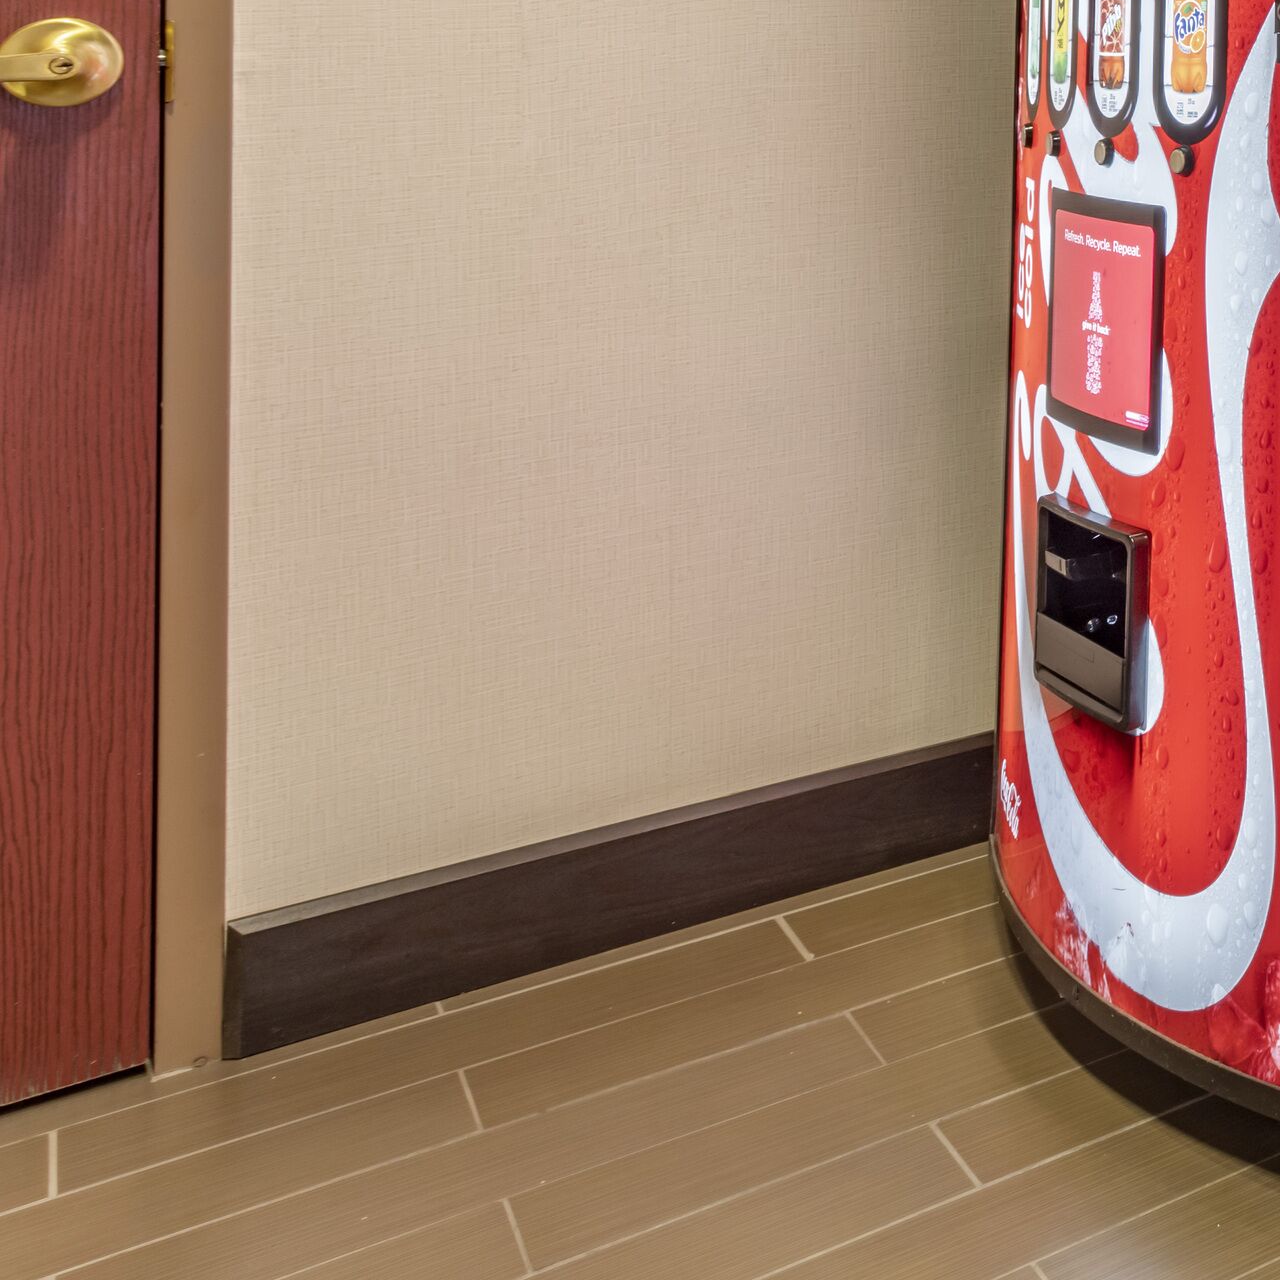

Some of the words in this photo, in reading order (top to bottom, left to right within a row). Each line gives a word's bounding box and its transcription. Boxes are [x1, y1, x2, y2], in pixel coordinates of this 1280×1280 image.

[1064, 228, 1085, 246] Refresh.
[1085, 234, 1112, 252] Recycle.
[1112, 240, 1142, 258] Repeat.
